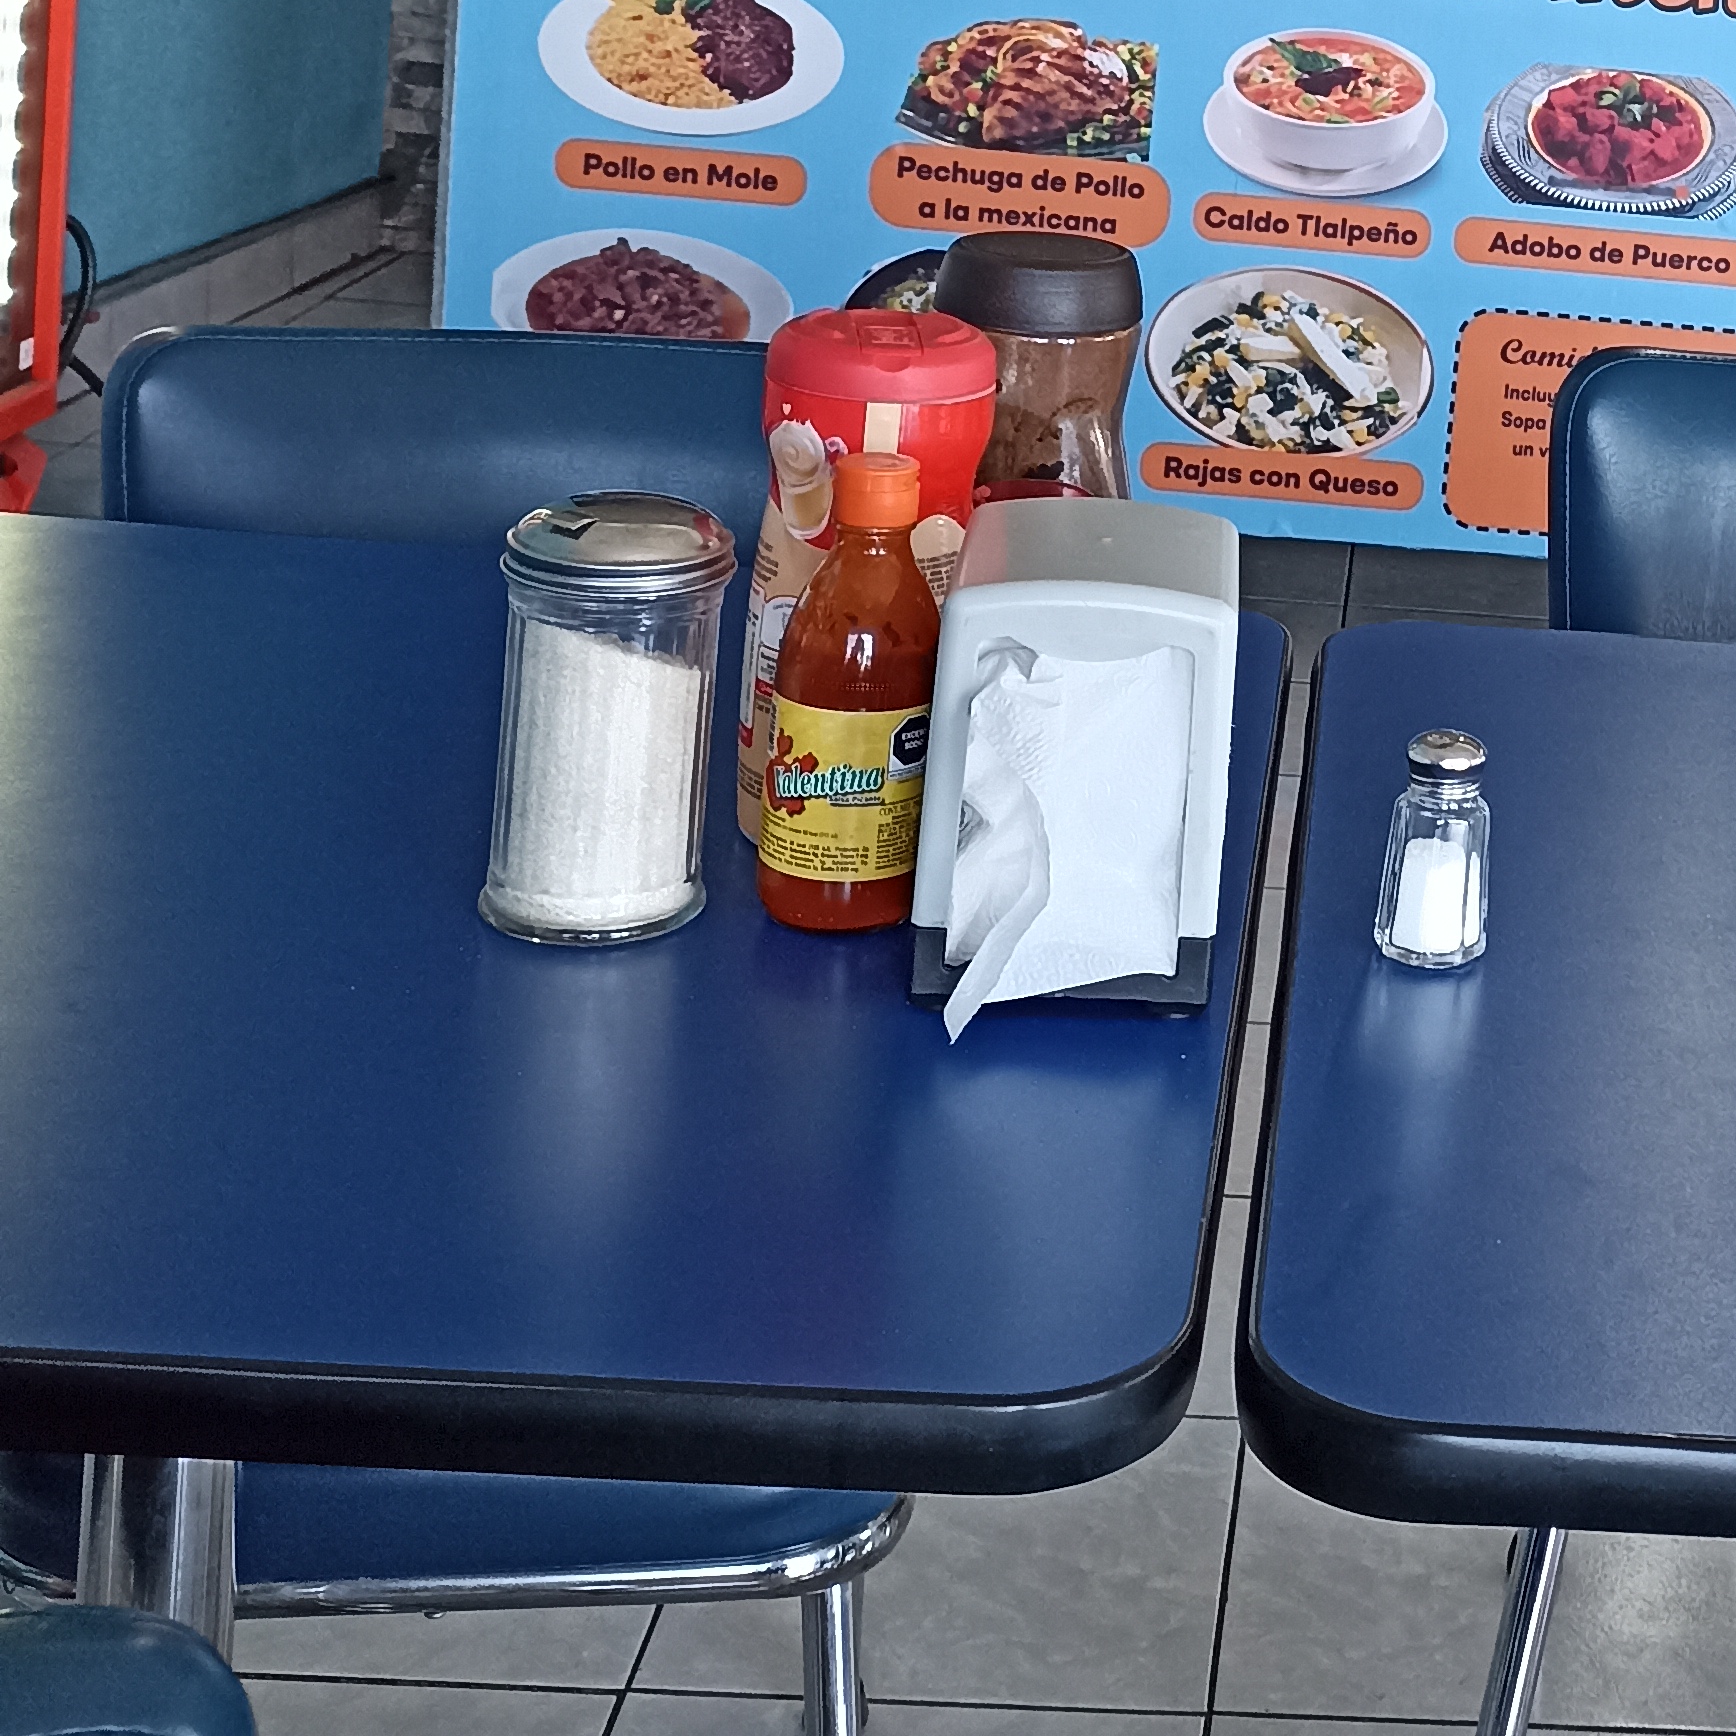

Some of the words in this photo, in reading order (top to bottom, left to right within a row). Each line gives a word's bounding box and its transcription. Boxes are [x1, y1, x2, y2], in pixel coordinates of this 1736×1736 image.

[583, 153, 655, 181] Pollo
[663, 166, 698, 184] en
[707, 164, 778, 191] Mole
[897, 156, 1023, 193] Pechuga
[1031, 169, 1066, 192] de
[1075, 171, 1145, 199] Pollo
[918, 200, 936, 218] a
[945, 198, 969, 221] la
[978, 206, 1117, 234] mexicana
[1204, 206, 1290, 234] Caldo
[1296, 214, 1418, 247] Tlalpeño
[1488, 231, 1582, 260] Adobo
[1589, 241, 1624, 264] de
[1632, 243, 1731, 274] Puerco
[1500, 338, 1598, 369] Comi
[1504, 383, 1557, 409] Incluy
[1501, 411, 1547, 433] Sopa
[1512, 444, 1534, 457] un
[1163, 456, 1242, 487] Rajas
[1249, 468, 1300, 489] con
[1309, 468, 1399, 497] Queso
[774, 762, 884, 798] Valentina
